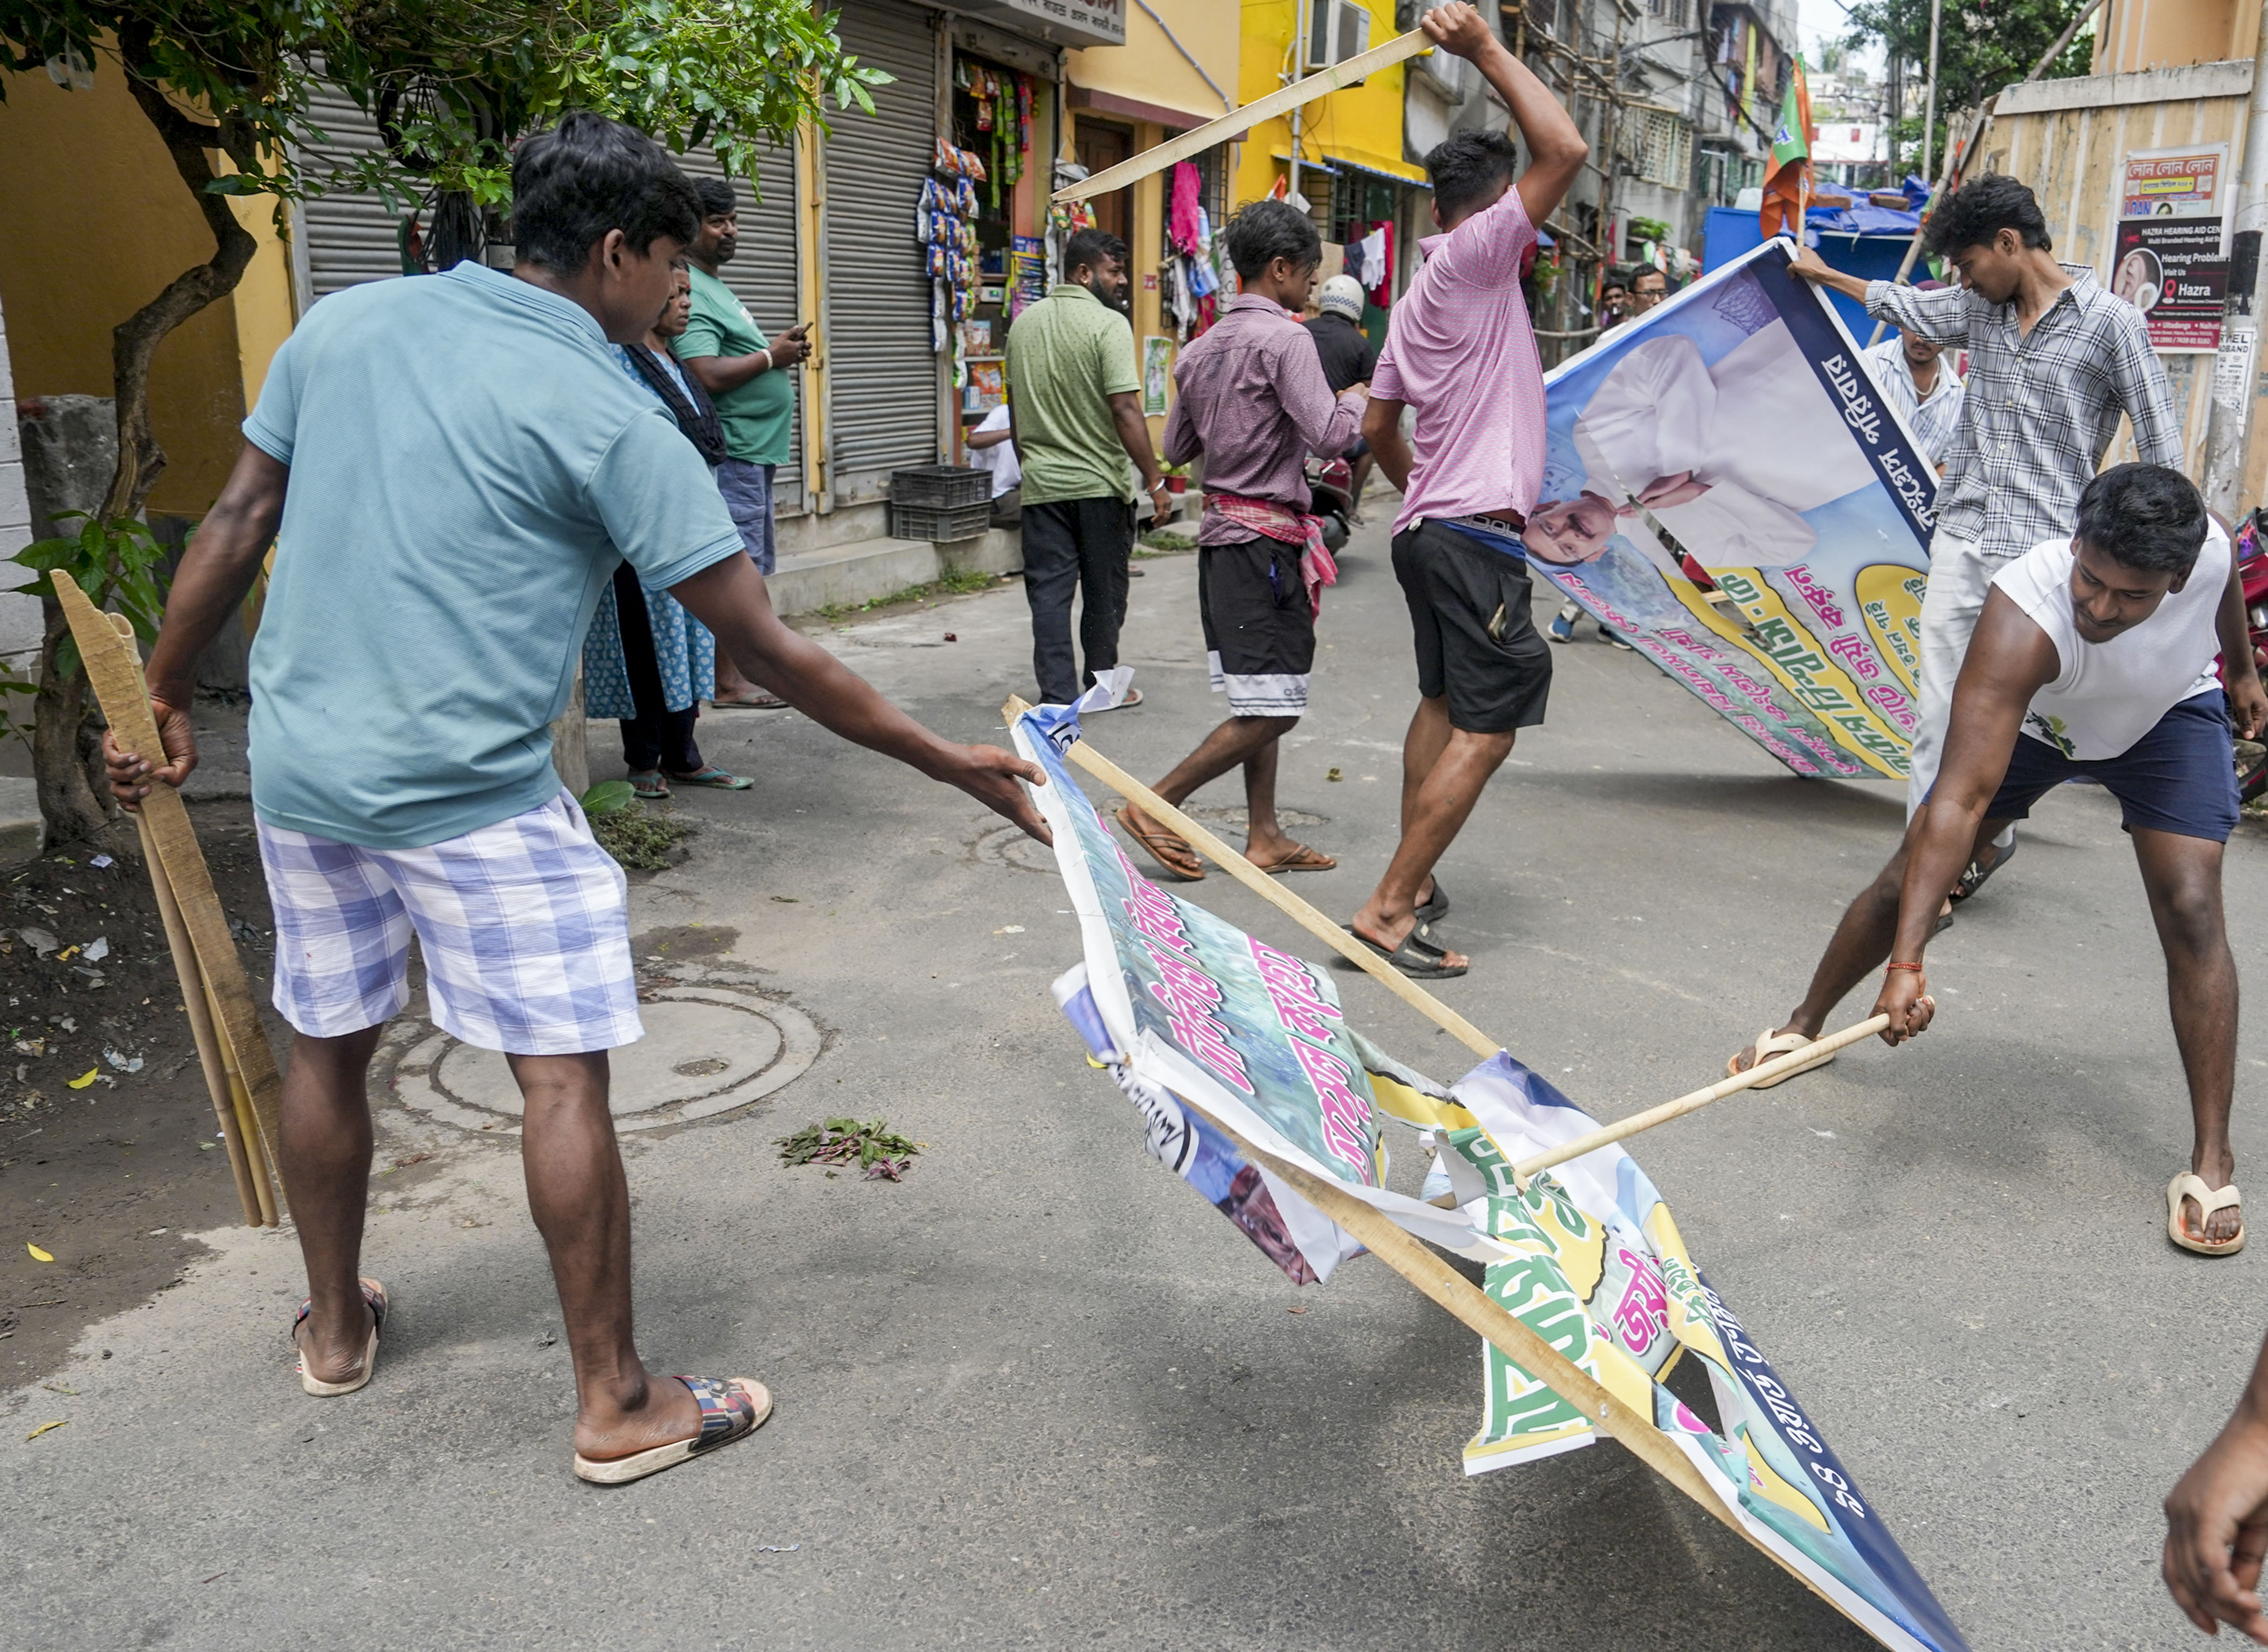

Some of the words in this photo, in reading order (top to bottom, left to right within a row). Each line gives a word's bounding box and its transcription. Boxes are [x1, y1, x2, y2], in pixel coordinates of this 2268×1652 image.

[2129, 163, 2156, 177] লোন
[2157, 161, 2184, 175] লোন
[2186, 159, 2215, 173] লোন
[2141, 228, 2162, 236] HAZRA
[2163, 226, 2193, 235] HEARING
[2194, 226, 2206, 234] AID
[2162, 254, 2191, 265] Hearing
[2193, 252, 2226, 262] Problem
[2183, 236, 2204, 244] Hearing
[2178, 284, 2211, 296] Hazra
[1821, 354, 1880, 444] পরিবার
[1878, 448, 1935, 532] কংগ্রেস
[1553, 571, 1640, 633] কেন্দ্রের
[1714, 572, 1761, 608] কে
[1781, 565, 1846, 632] করুন
[1864, 599, 1890, 630] পাই
[1634, 637, 1741, 712] বিধানসভা
[1830, 633, 1882, 684] জয়ী
[1714, 664, 1790, 723] কংগ্রেস
[1735, 714, 1820, 774] টালিগঞ্জ
[1784, 726, 1862, 775] তৃণমূল
[1611, 1248, 1671, 1357] জয়ী
[1736, 1366, 1823, 1454] ওয়ার্ড
